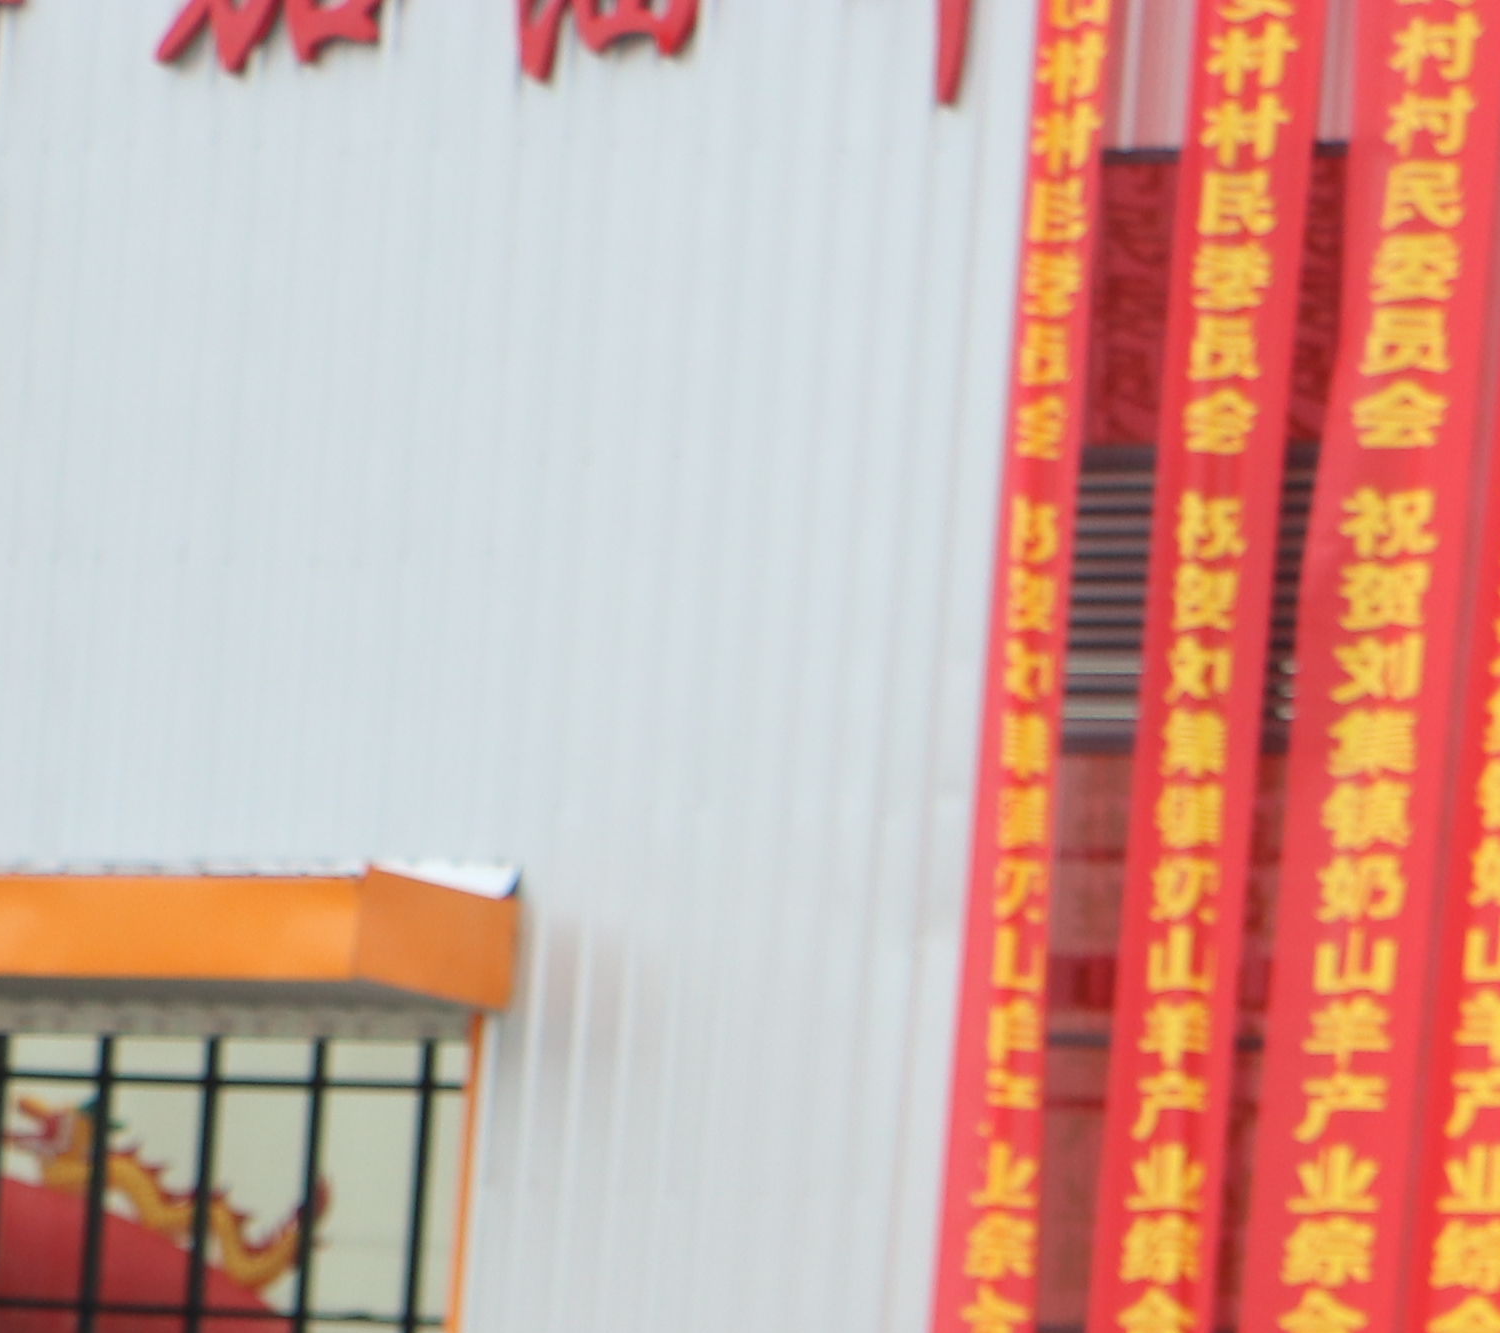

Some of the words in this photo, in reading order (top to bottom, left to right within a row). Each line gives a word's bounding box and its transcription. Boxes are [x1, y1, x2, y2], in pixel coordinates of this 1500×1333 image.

[1186, 0, 1296, 453] 村村民委员会
[1354, 0, 1481, 447] 村村民委员会
